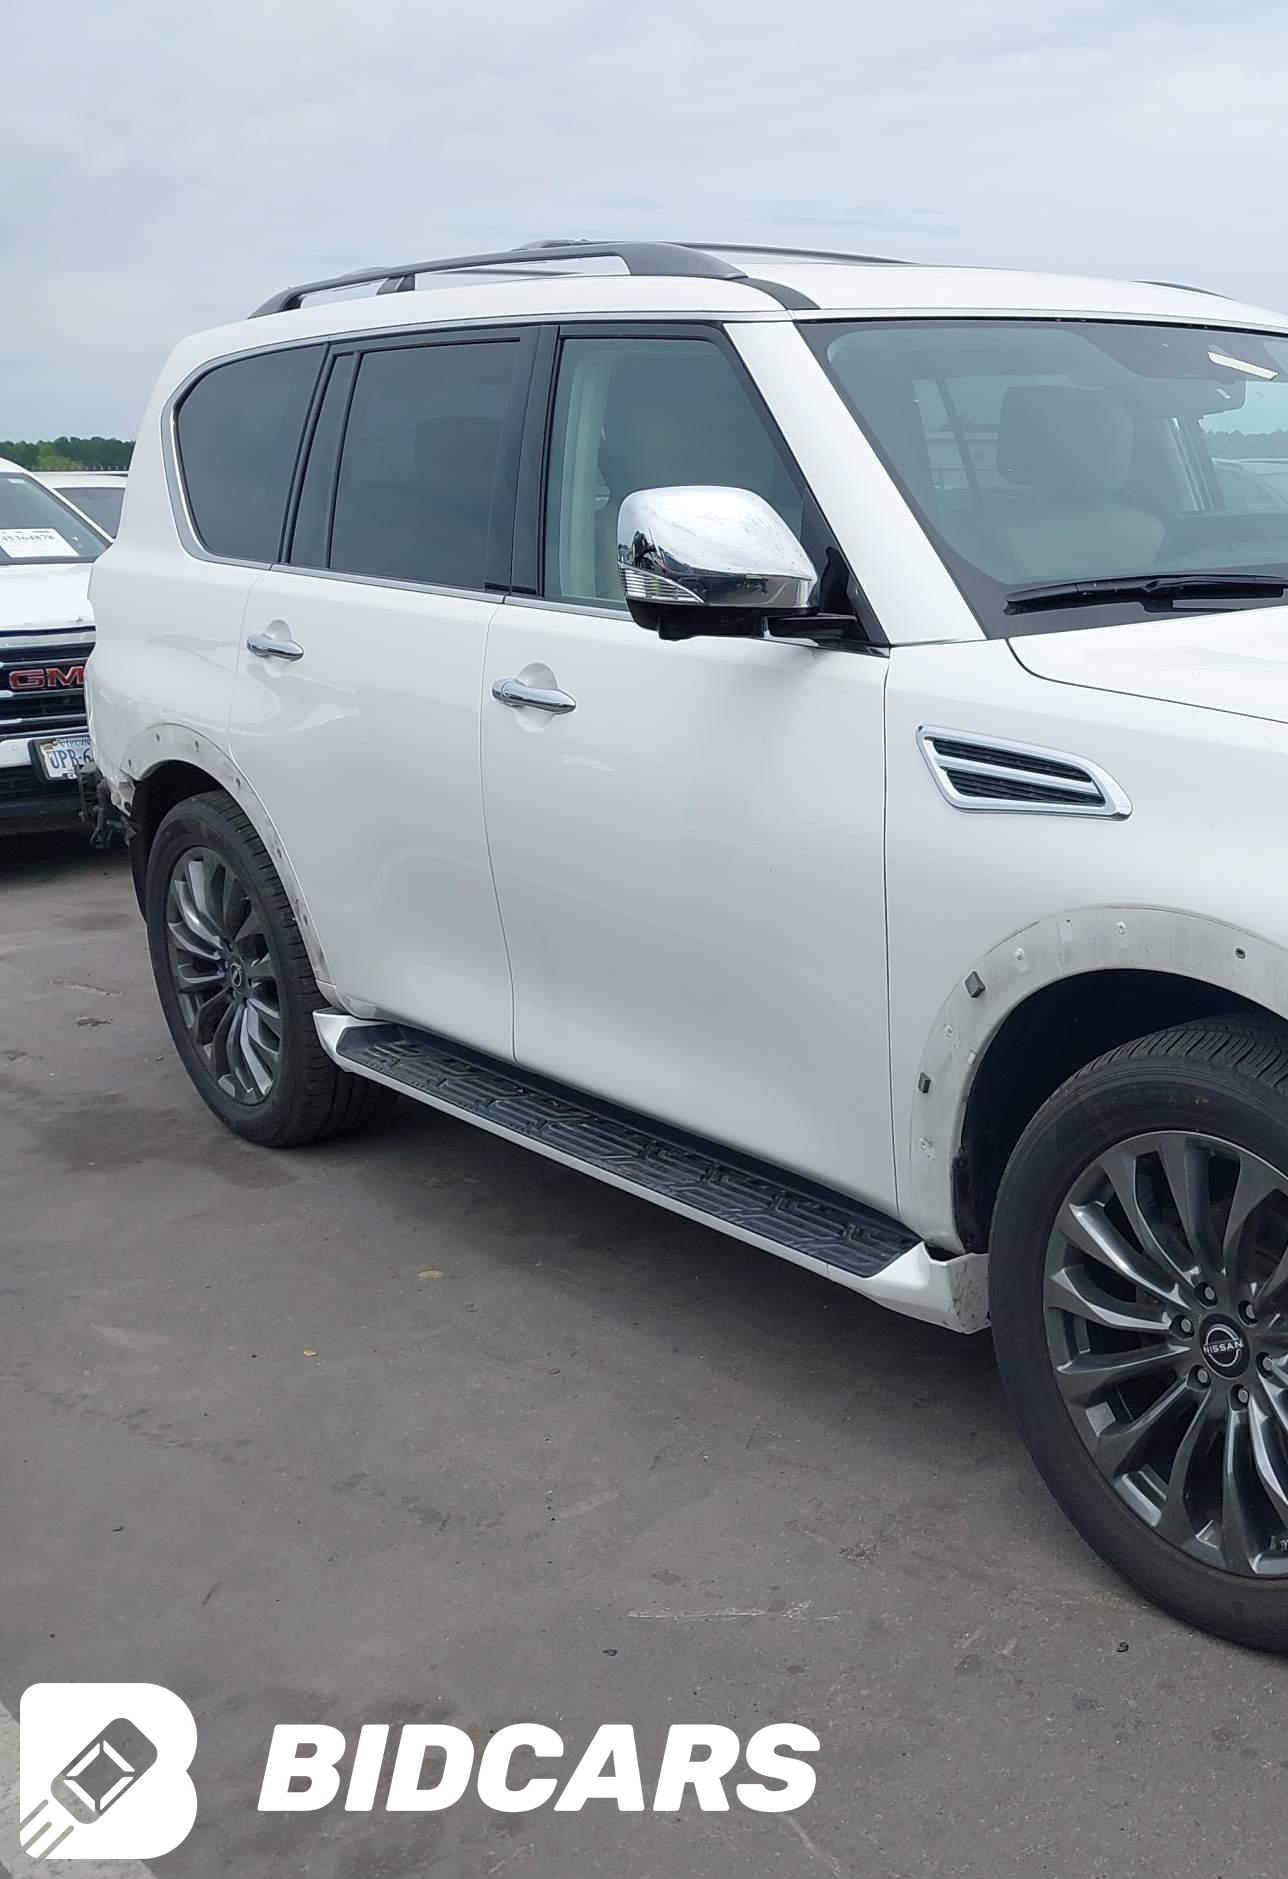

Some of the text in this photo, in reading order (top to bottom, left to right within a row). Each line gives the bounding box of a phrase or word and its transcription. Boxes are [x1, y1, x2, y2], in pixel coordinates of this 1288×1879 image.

[9, 666, 85, 690] GM
[60, 738, 91, 748] VIRGIN
[1203, 1340, 1244, 1354] NISSAN
